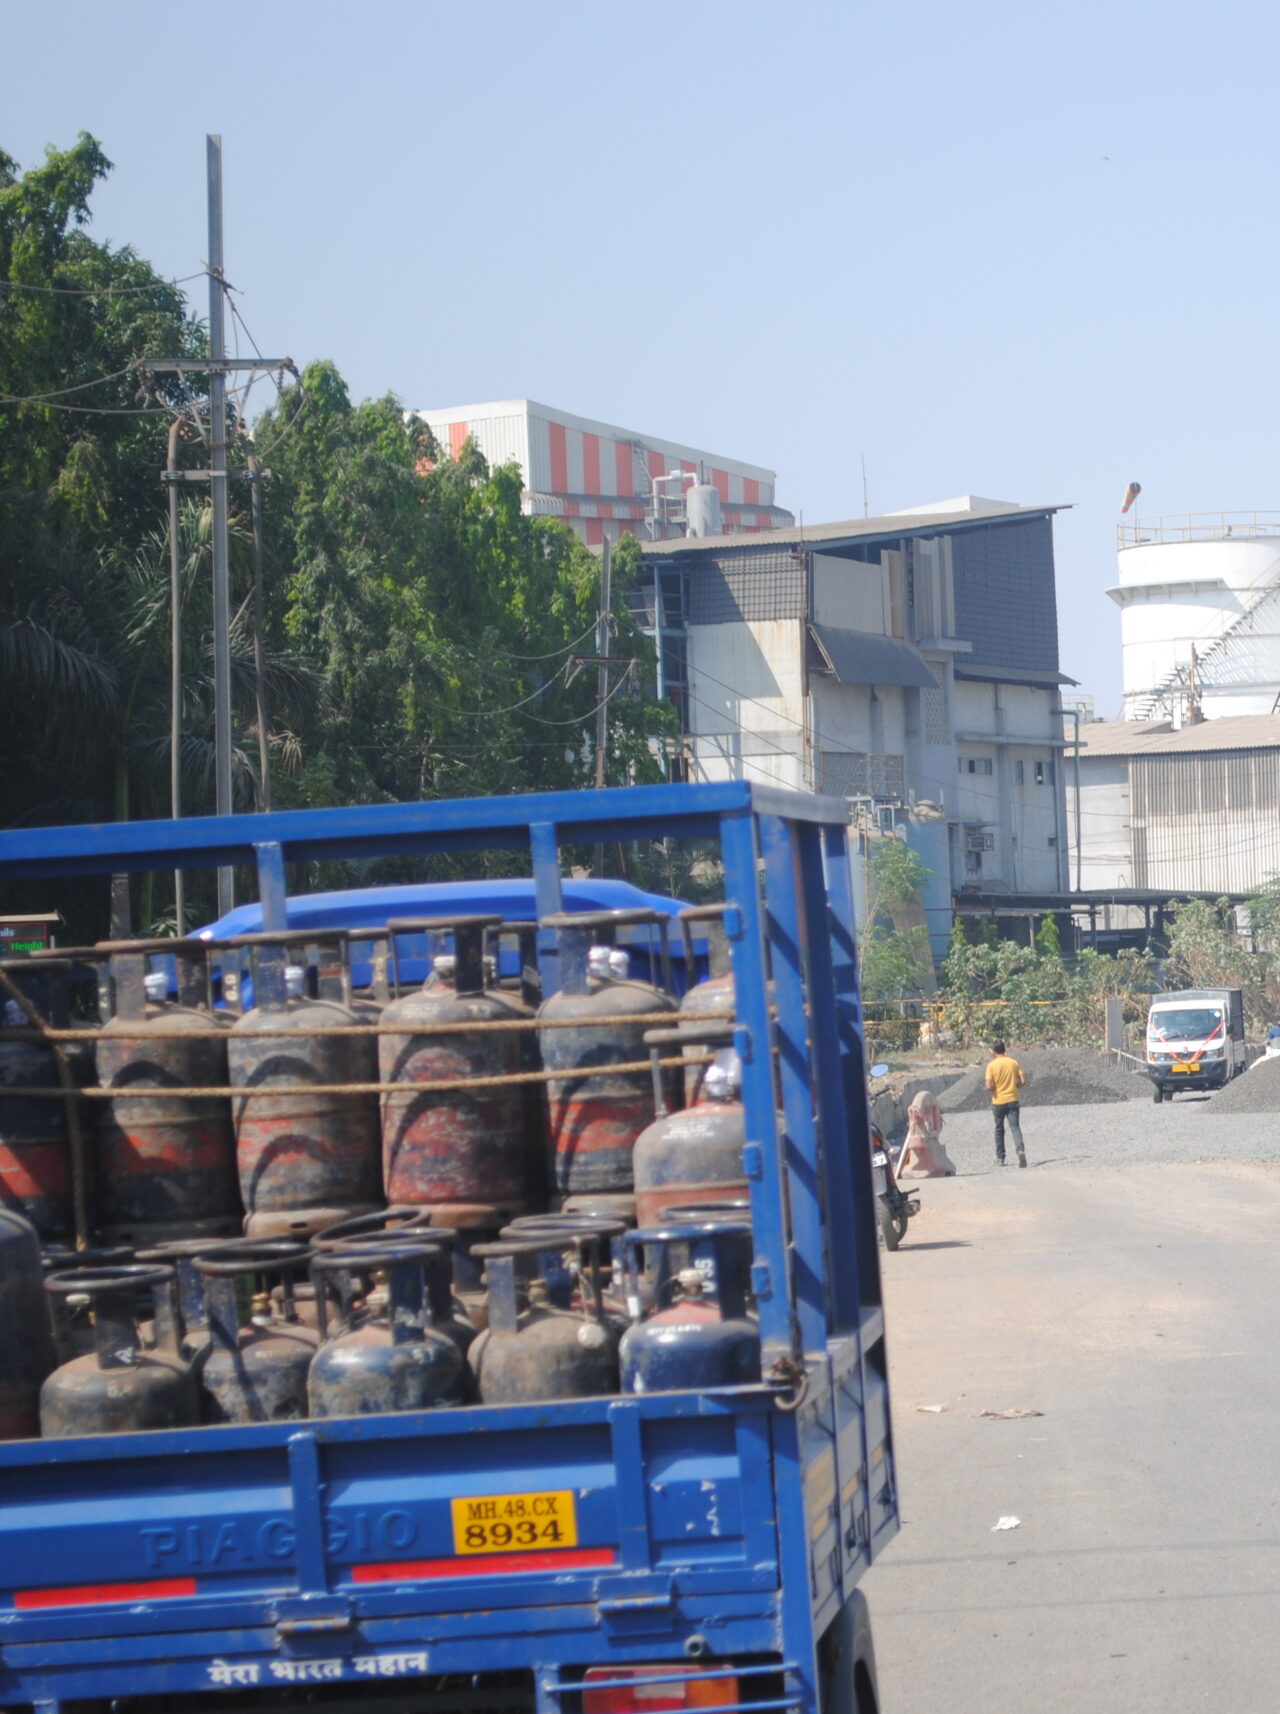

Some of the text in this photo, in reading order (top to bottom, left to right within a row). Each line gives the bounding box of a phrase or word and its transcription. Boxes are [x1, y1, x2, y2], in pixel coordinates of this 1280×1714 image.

[467, 1496, 559, 1520] MH.48.CX
[139, 1509, 418, 1570] PIAGGIO
[464, 1519, 565, 1549] 8934
[207, 1651, 428, 1685] मेरा भारत महान
